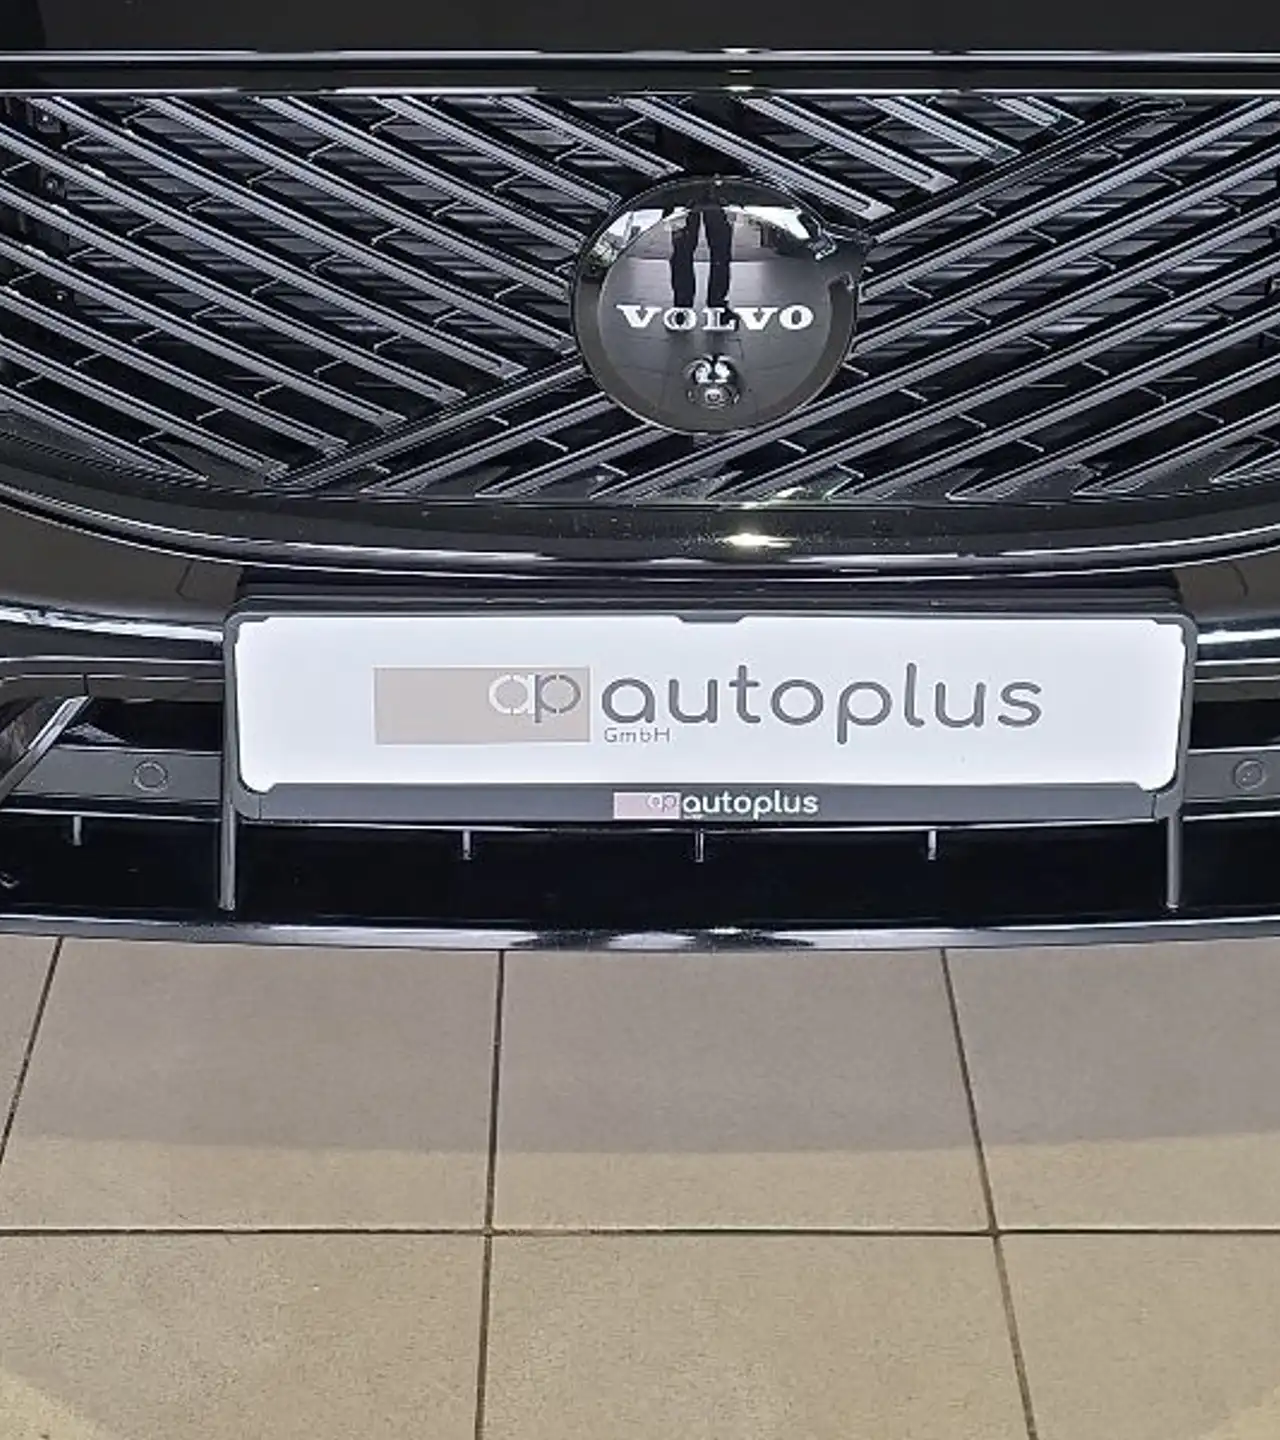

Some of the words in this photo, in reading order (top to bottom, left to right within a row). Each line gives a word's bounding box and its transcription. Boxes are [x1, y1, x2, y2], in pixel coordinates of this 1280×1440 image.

[617, 304, 815, 330] VOLVO
[601, 662, 1043, 745] autoplus
[603, 728, 671, 743] GmbH
[682, 790, 819, 820] autoplus
